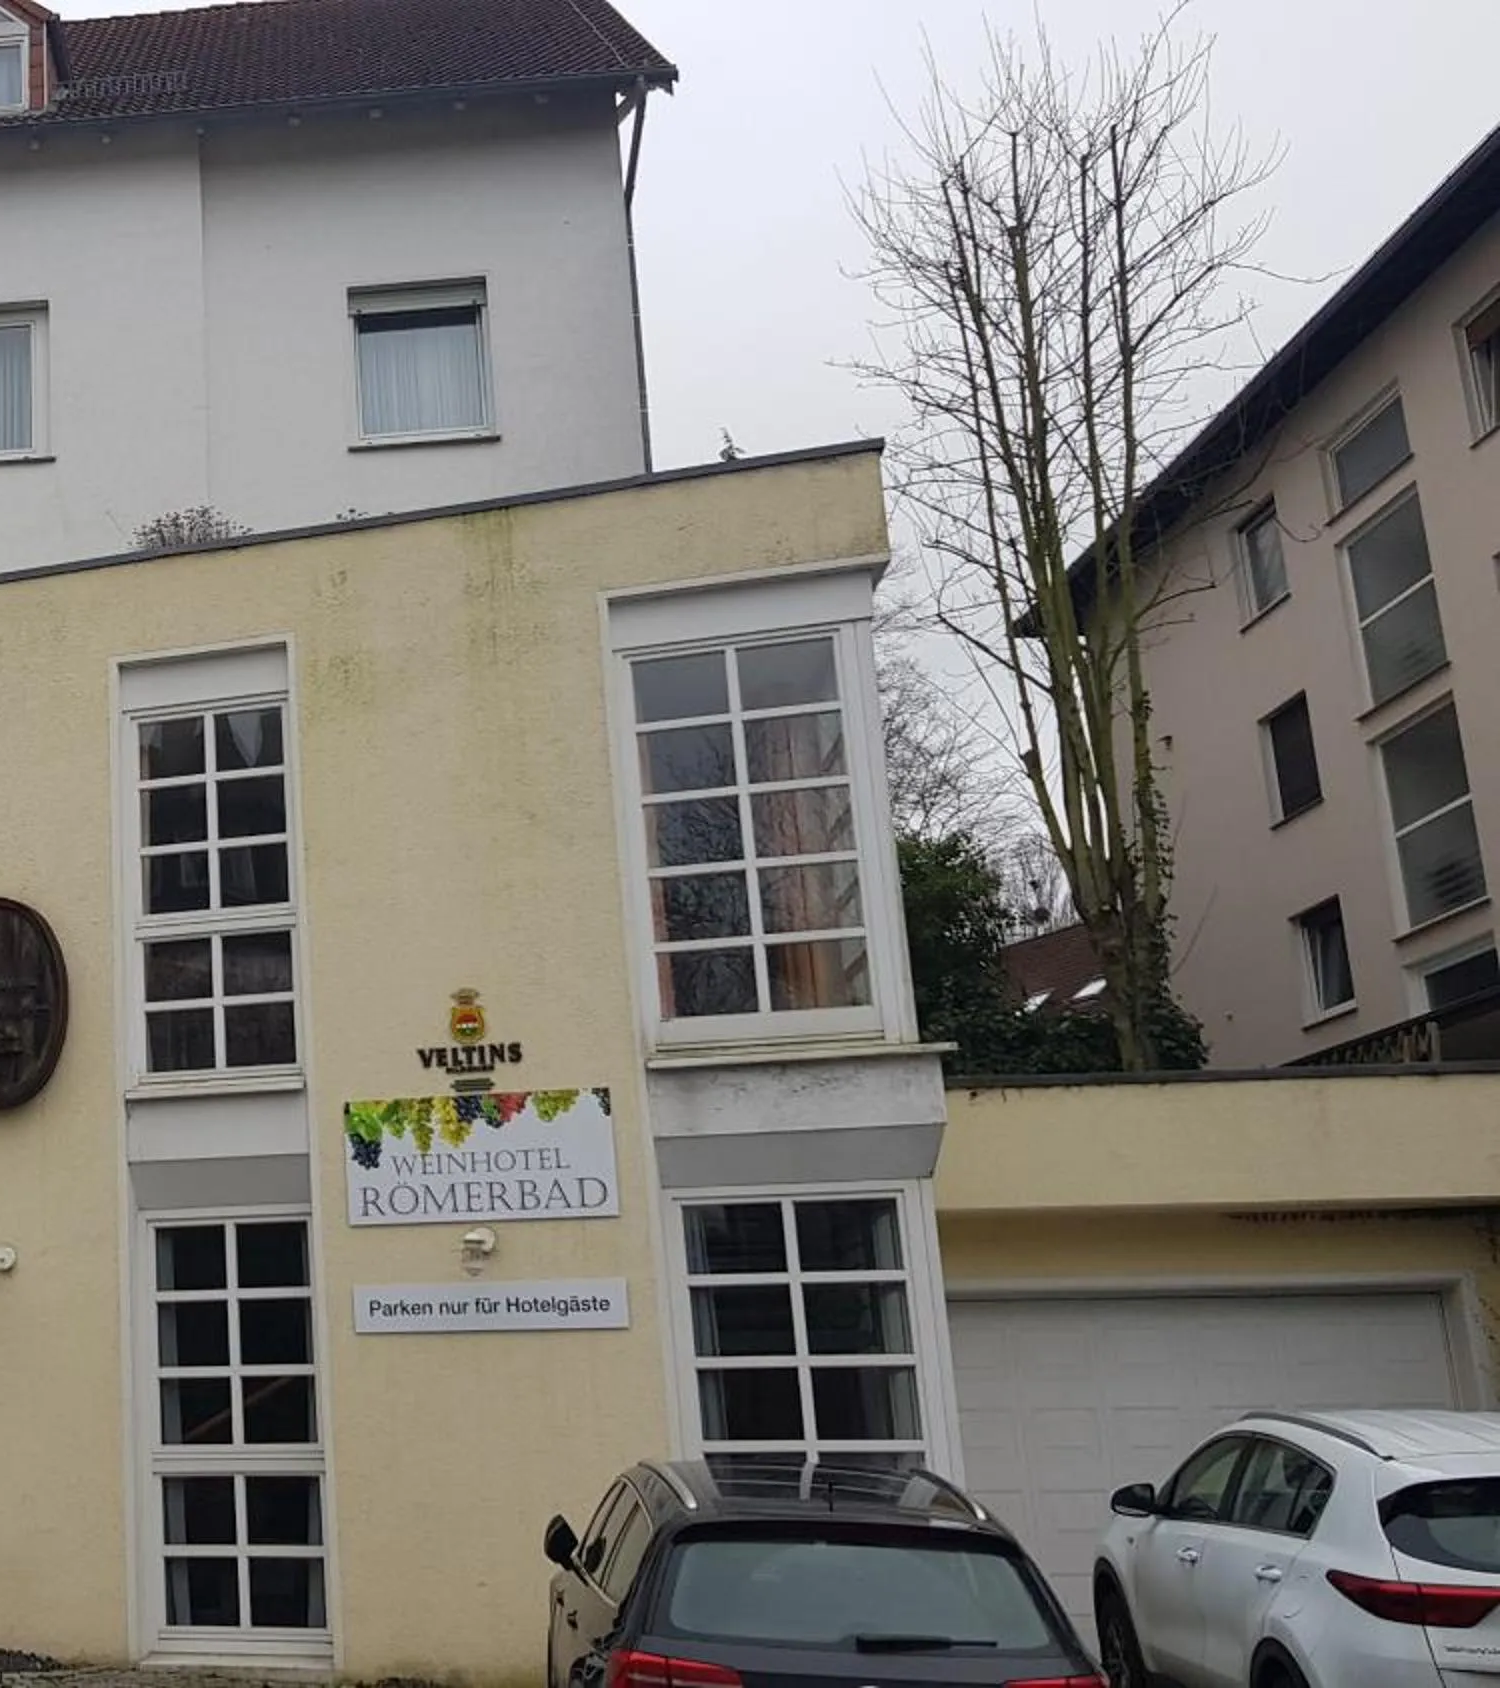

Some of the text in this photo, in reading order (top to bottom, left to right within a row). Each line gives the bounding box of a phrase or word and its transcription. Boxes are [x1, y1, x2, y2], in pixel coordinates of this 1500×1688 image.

[417, 1042, 523, 1069] VELTINS
[390, 1148, 571, 1177] WEINHOTEL
[359, 1176, 609, 1217] RÖMERBAD
[369, 1296, 611, 1317] Parken nur für Hotelgäste
